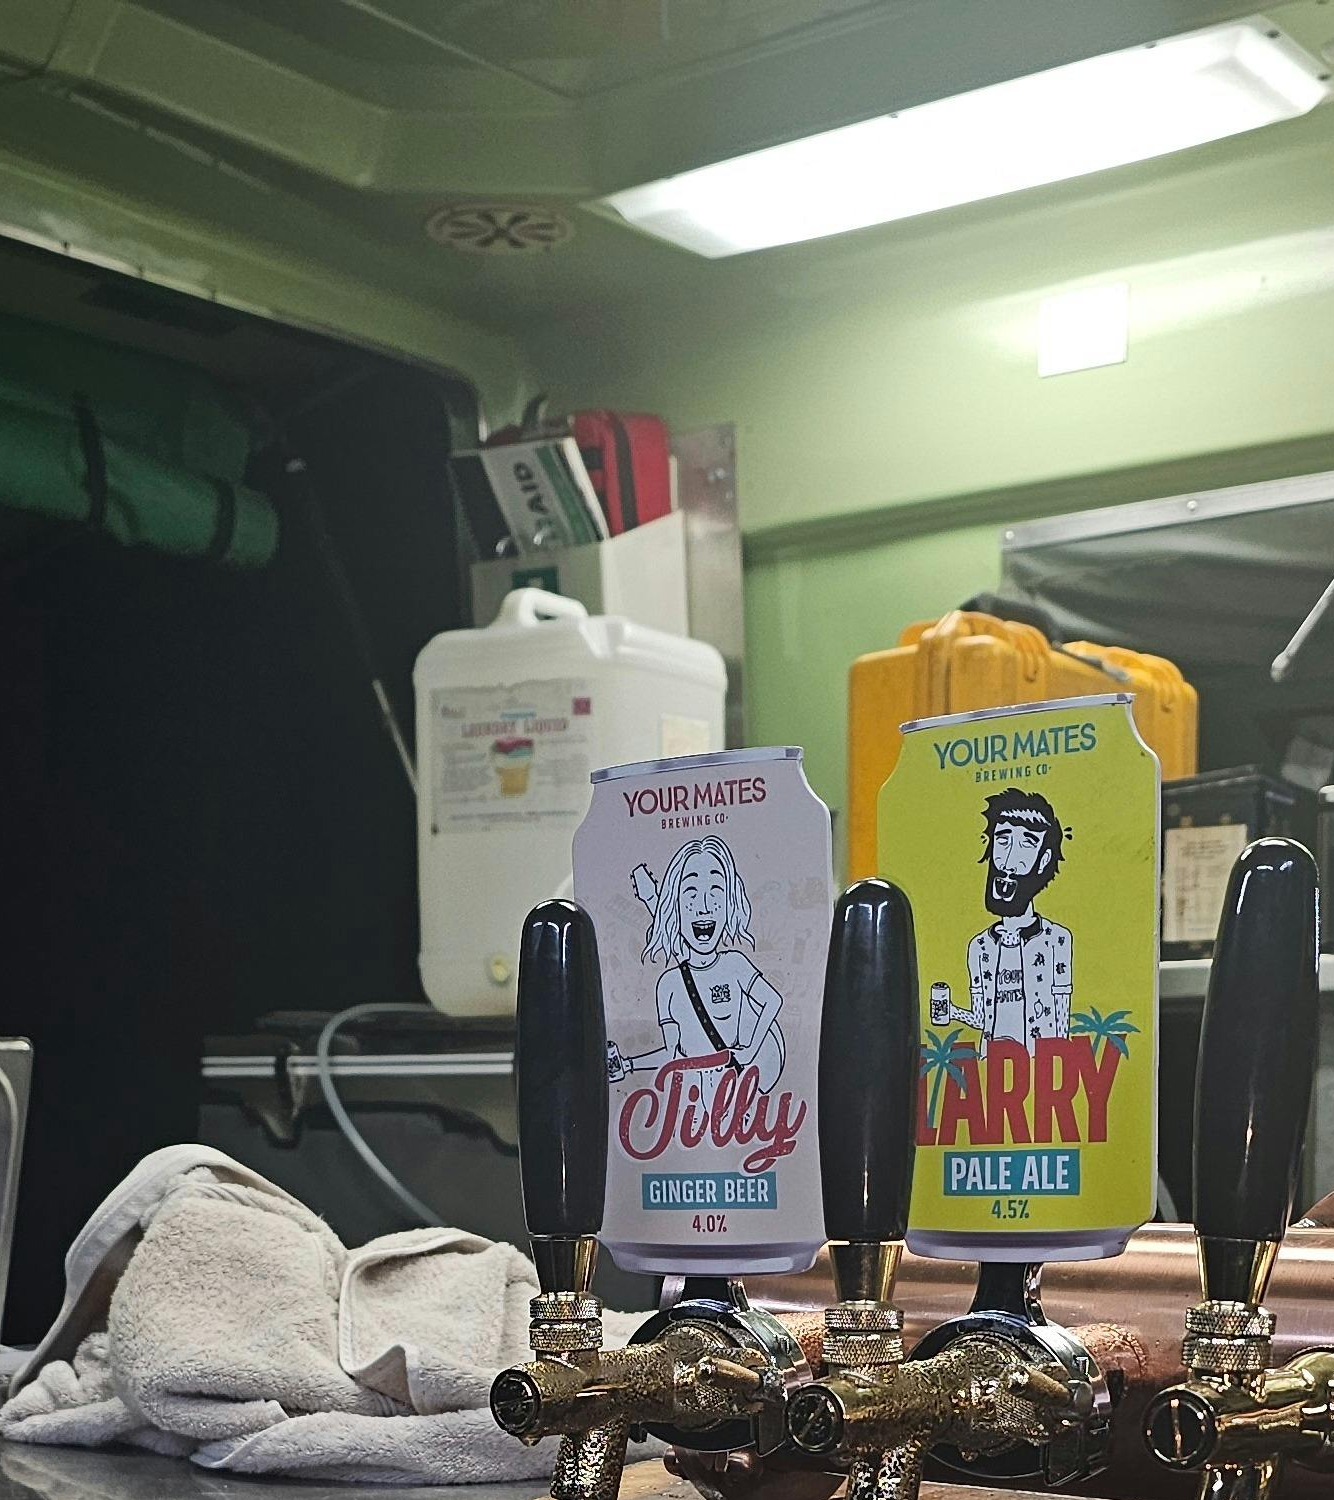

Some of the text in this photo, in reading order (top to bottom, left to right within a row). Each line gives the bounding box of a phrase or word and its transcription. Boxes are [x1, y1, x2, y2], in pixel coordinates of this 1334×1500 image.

[933, 722, 1097, 770] YOUR MATES
[975, 765, 1031, 783] BREWING
[623, 776, 767, 818] YOUR MATES
[661, 813, 711, 830] BREWING
[618, 1049, 807, 1174] Tilly
[950, 1154, 1070, 1191] PALE ALE
[649, 1178, 769, 1204] GINGER BEER
[991, 1199, 1030, 1219] 4.5%
[692, 1214, 728, 1233] 4.0%
